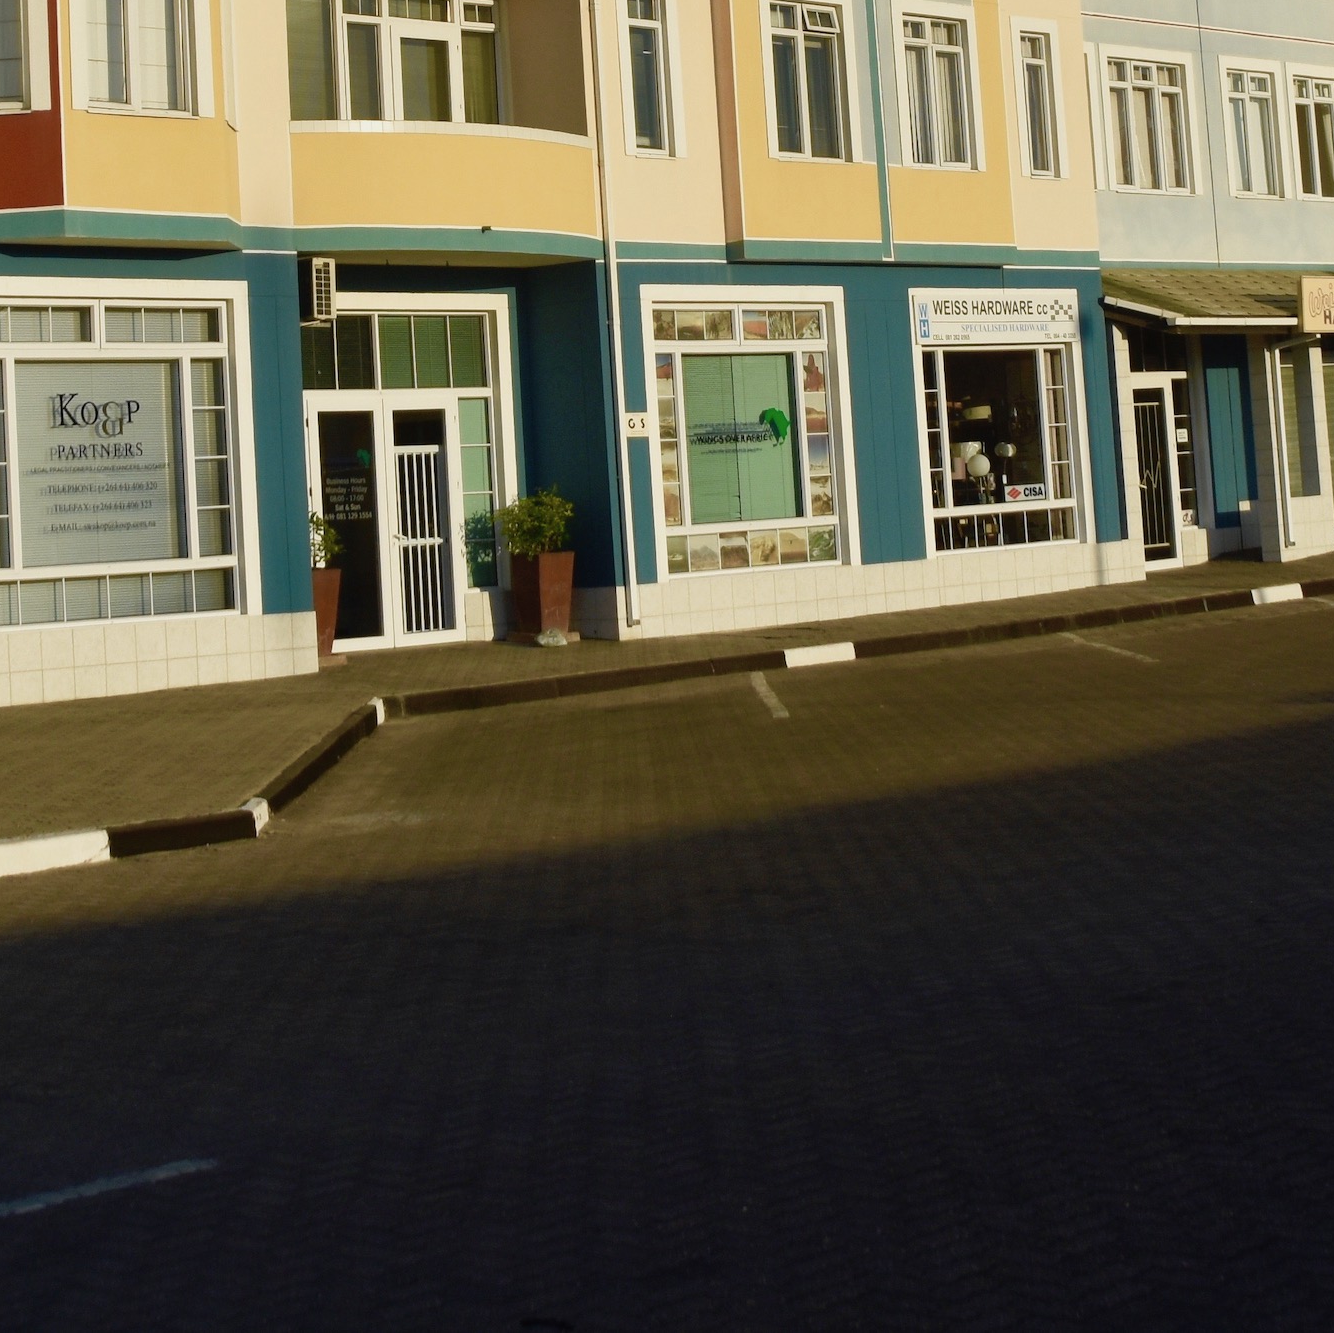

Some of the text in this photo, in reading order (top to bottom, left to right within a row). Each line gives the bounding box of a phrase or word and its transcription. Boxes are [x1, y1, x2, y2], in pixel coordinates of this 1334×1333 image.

[932, 300, 968, 316] WEISS
[972, 300, 1034, 316] HARDWARE
[961, 323, 1049, 332] SPECIALISED HARDWARE
[628, 418, 645, 429] G S
[696, 435, 724, 444] WINGS
[725, 434, 745, 443] OVER
[56, 442, 144, 460] PARTNERS
[326, 478, 349, 486] Business
